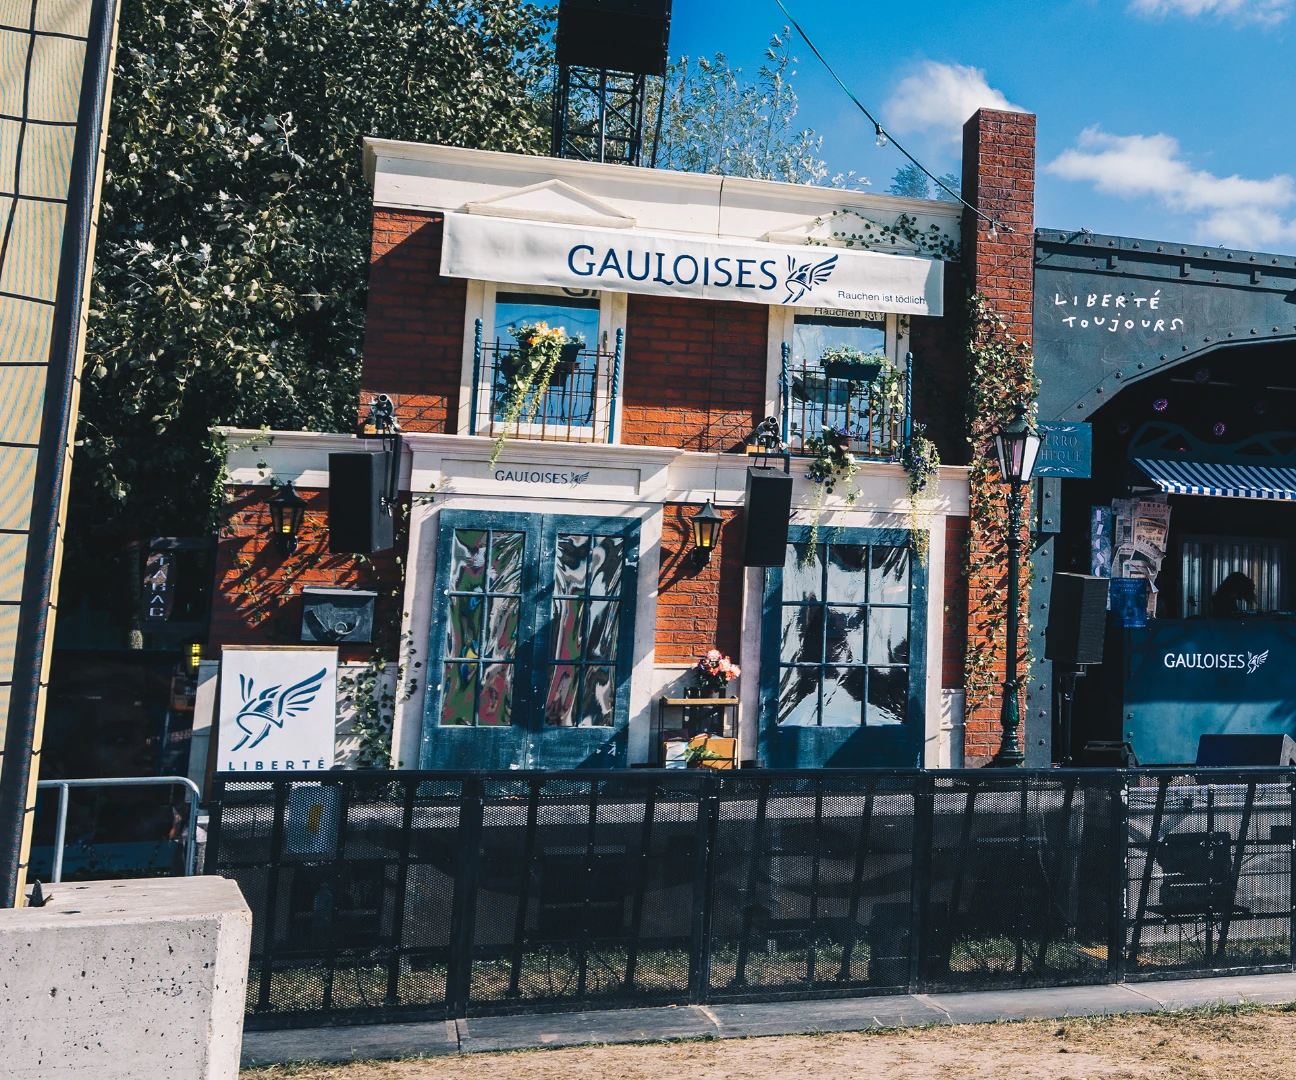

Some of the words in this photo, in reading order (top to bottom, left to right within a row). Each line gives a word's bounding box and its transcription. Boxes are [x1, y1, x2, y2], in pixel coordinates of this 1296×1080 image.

[567, 243, 777, 291] GAULOISES
[837, 290, 880, 301] Rauchen
[882, 294, 893, 303] ist
[895, 295, 925, 304] tödlich
[1055, 289, 1161, 309] LIBERTÉ
[1044, 434, 1078, 447] ERRO
[1040, 449, 1082, 463] HEQUE
[494, 470, 568, 484] GAULOISES
[149, 557, 169, 617] TABAC
[1163, 652, 1246, 669] GAULOISES
[228, 756, 325, 771] LIBERTÉ
